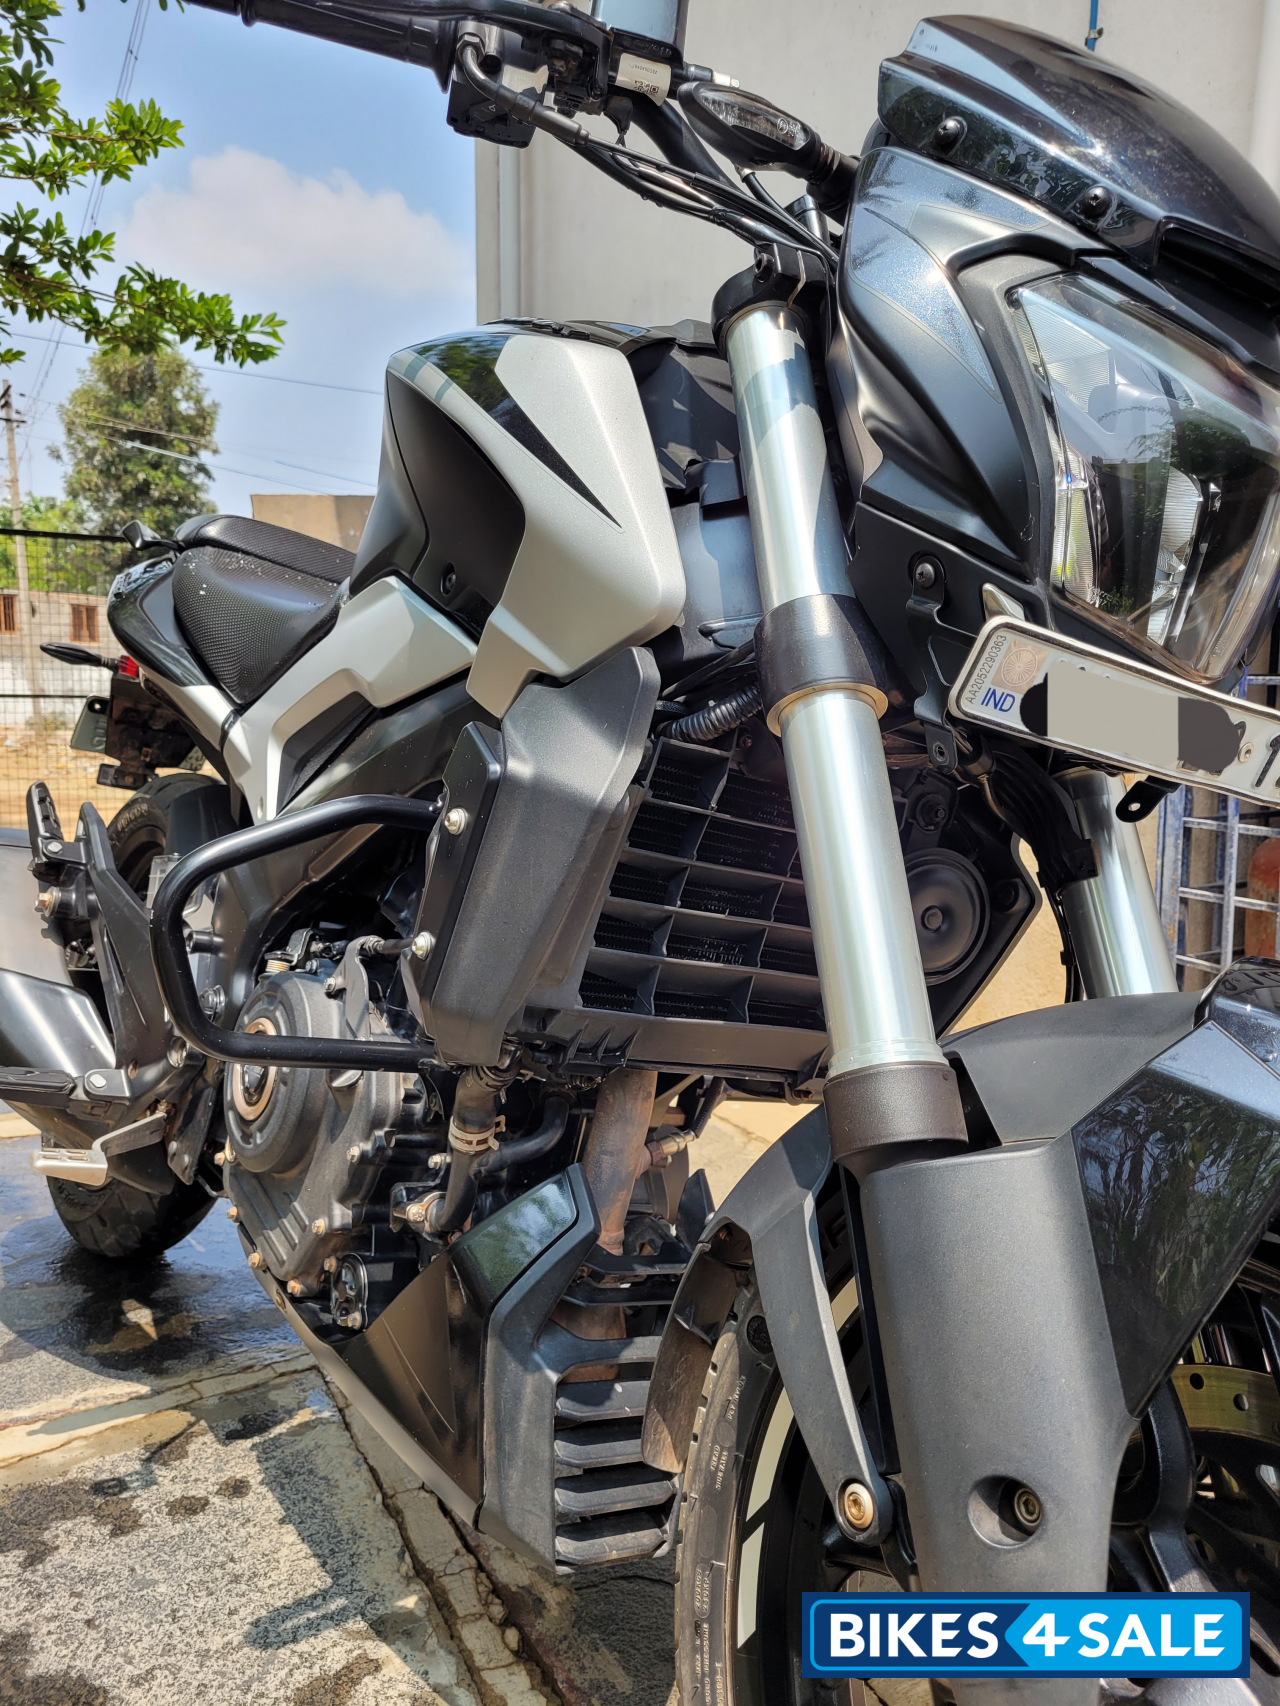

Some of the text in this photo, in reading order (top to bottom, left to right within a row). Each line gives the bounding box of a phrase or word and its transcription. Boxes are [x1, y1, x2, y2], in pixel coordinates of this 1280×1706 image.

[965, 635, 1007, 704] AA2052290363
[981, 687, 1015, 712] IND
[715, 1661, 724, 1706] 5308-E
